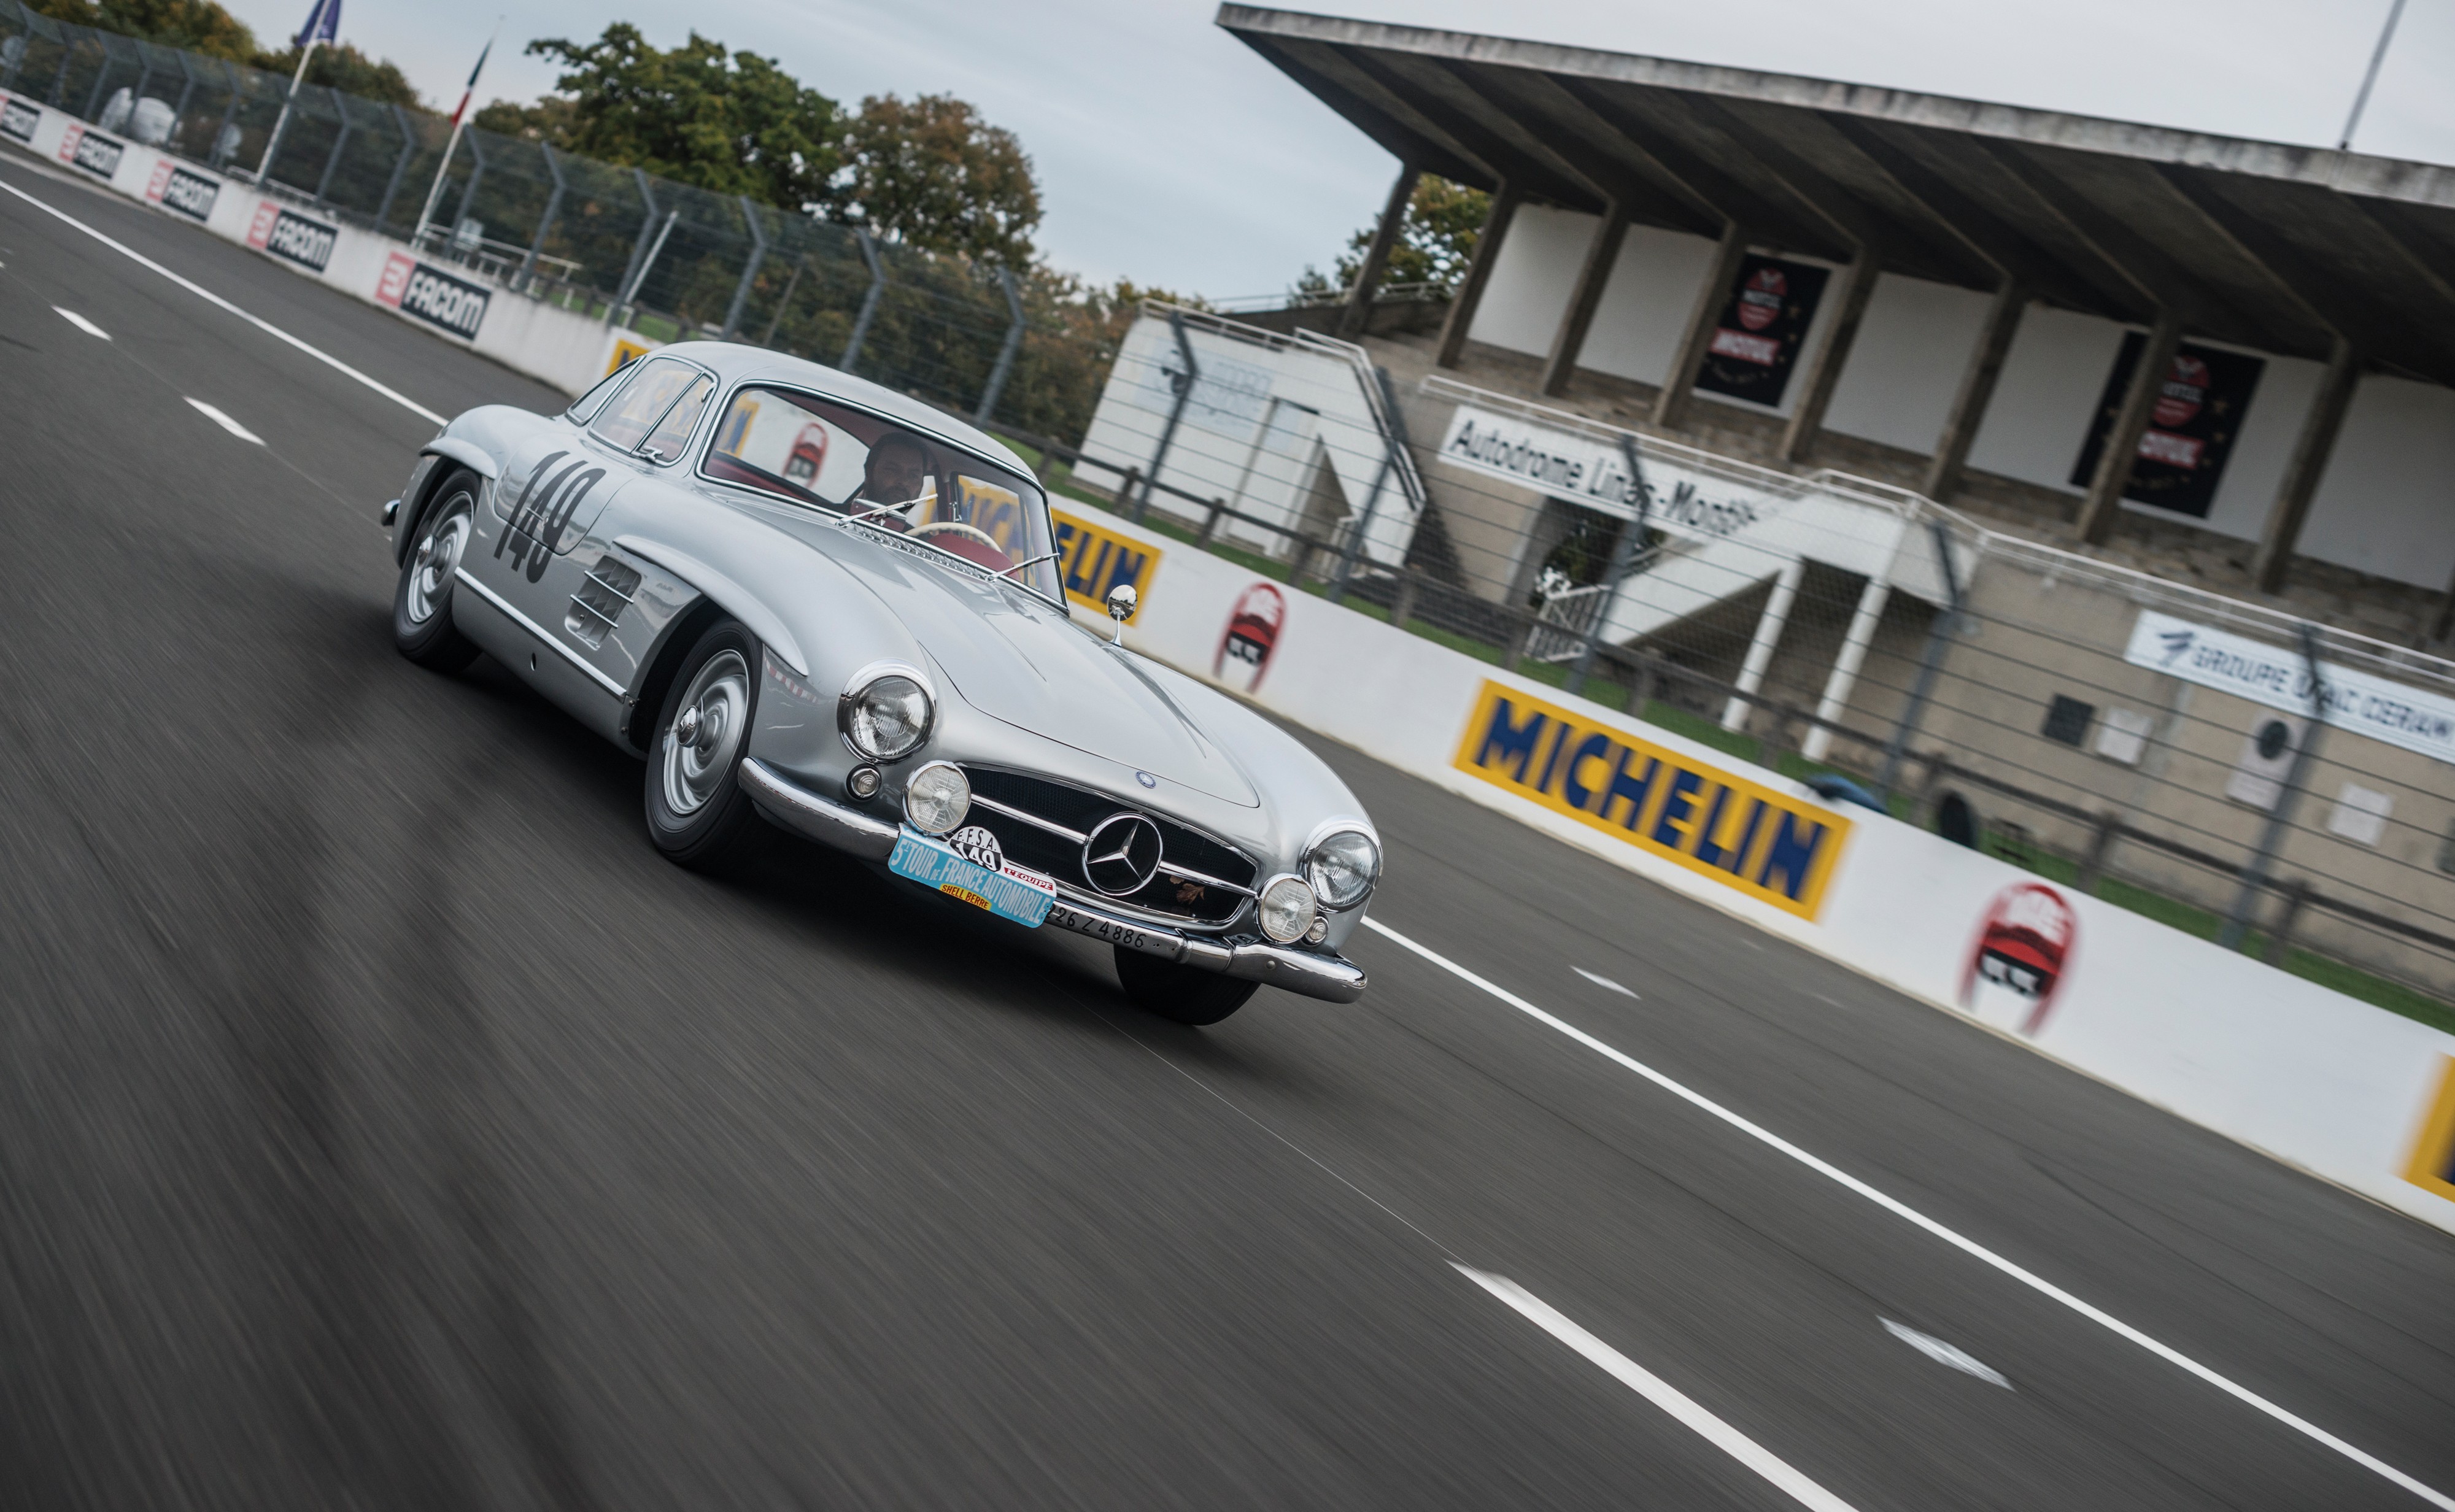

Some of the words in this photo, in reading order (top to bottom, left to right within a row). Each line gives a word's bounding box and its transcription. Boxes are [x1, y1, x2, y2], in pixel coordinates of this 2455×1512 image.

[164, 172, 216, 216] FACOM
[268, 216, 332, 266] FACOM
[404, 271, 486, 333] FACOM
[1448, 420, 1583, 490] Autodrome
[2192, 646, 2290, 693] GROUPE
[1473, 695, 1831, 904] MICHELIN
[956, 842, 997, 872] 149
[1007, 868, 1053, 890] L'EQUIPE
[902, 843, 938, 879] TOUR
[931, 869, 939, 881] DE
[938, 857, 984, 893] FRANCE
[981, 873, 1051, 924] AUTOMOBILE
[941, 884, 963, 899] SHELL
[965, 892, 989, 909] BERRE
[1082, 917, 1096, 932] Z
[1099, 921, 1146, 947] 4886
